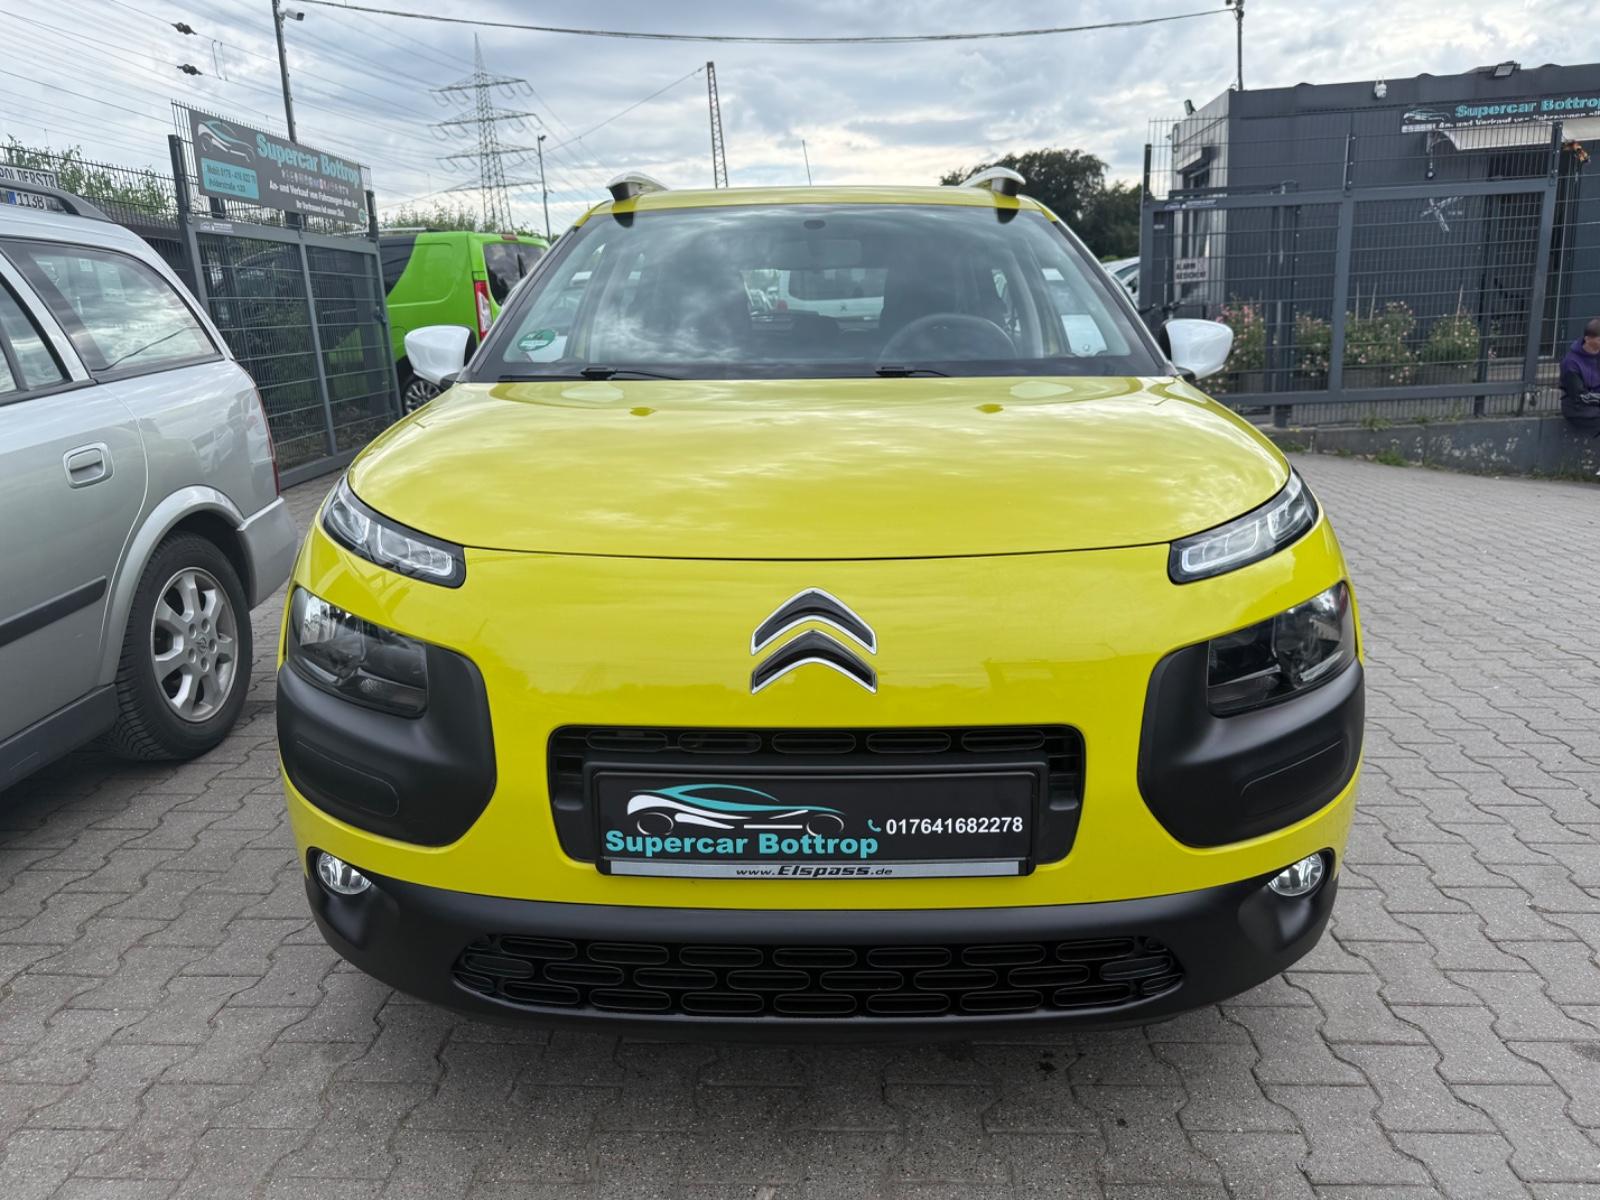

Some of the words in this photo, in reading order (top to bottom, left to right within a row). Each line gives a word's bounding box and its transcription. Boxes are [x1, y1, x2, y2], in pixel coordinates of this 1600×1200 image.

[1454, 102, 1537, 118] Supercar
[1540, 96, 1600, 111] Bottro
[256, 133, 318, 172] Supercar
[320, 154, 360, 189] Bottrop
[885, 817, 1024, 836] 017641682278
[605, 831, 748, 857] Supercar
[757, 832, 879, 858] Bottrop
[736, 865, 893, 880] www.Elspass.de
